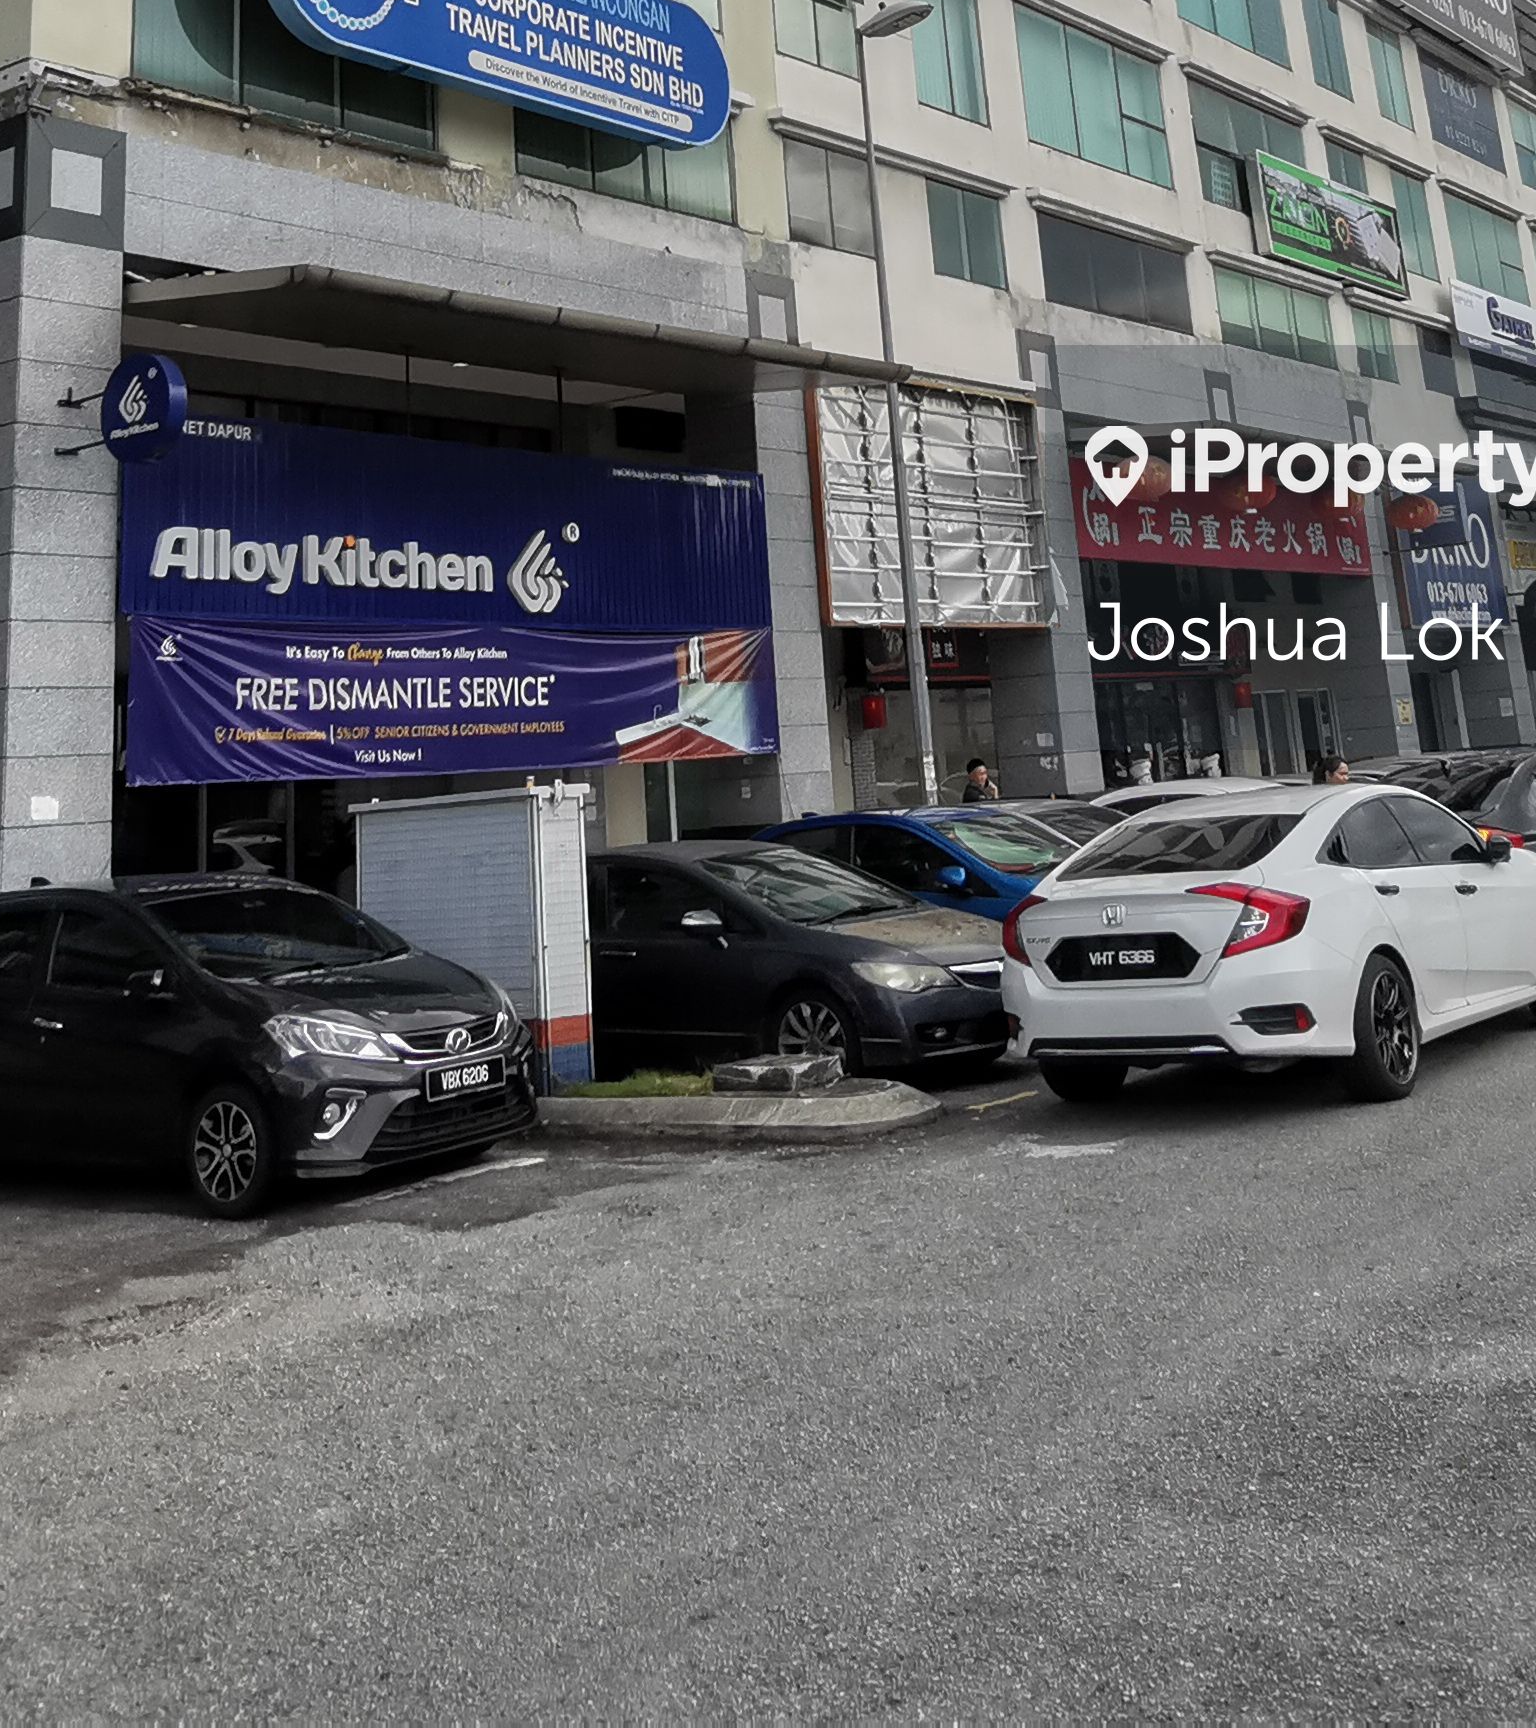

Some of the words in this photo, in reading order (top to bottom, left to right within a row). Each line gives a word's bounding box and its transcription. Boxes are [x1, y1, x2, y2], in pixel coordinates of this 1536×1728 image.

[445, 2, 522, 54] TRAVEL
[526, 29, 626, 85] PLANNERS
[629, 63, 665, 98] SDN
[668, 75, 704, 109] BHD
[595, 19, 684, 72] INCENTIVE
[485, 58, 525, 80] Discover
[525, 69, 541, 84] the
[541, 73, 568, 93] World
[569, 84, 579, 95] of
[579, 84, 617, 108] Incentive
[617, 97, 643, 116] Travel
[643, 105, 661, 120] with
[661, 109, 680, 125] CITP
[207, 421, 253, 442] DAPUR
[1137, 504, 1330, 558] 正宗重庆老火锅
[285, 645, 302, 659] It's
[304, 646, 330, 662] Easy
[332, 645, 346, 659] To
[386, 647, 410, 660] From
[410, 647, 441, 660] Others
[441, 647, 453, 660] To
[453, 647, 476, 662] Alloy
[476, 647, 509, 661] Kitchen
[235, 677, 299, 711] FREE
[308, 676, 452, 711] DISMANTLE
[374, 726, 410, 739] SENIOR
[411, 724, 450, 738] CITIZENS
[460, 722, 519, 736] GOVERNMENT
[520, 721, 566, 734] EMPLOYEES
[354, 748, 375, 763] Visit
[377, 749, 391, 763] Us
[392, 749, 415, 762] Now
[1089, 951, 1115, 965] VHT
[441, 1068, 462, 1091] VBX
[462, 1063, 489, 1086] 6206
